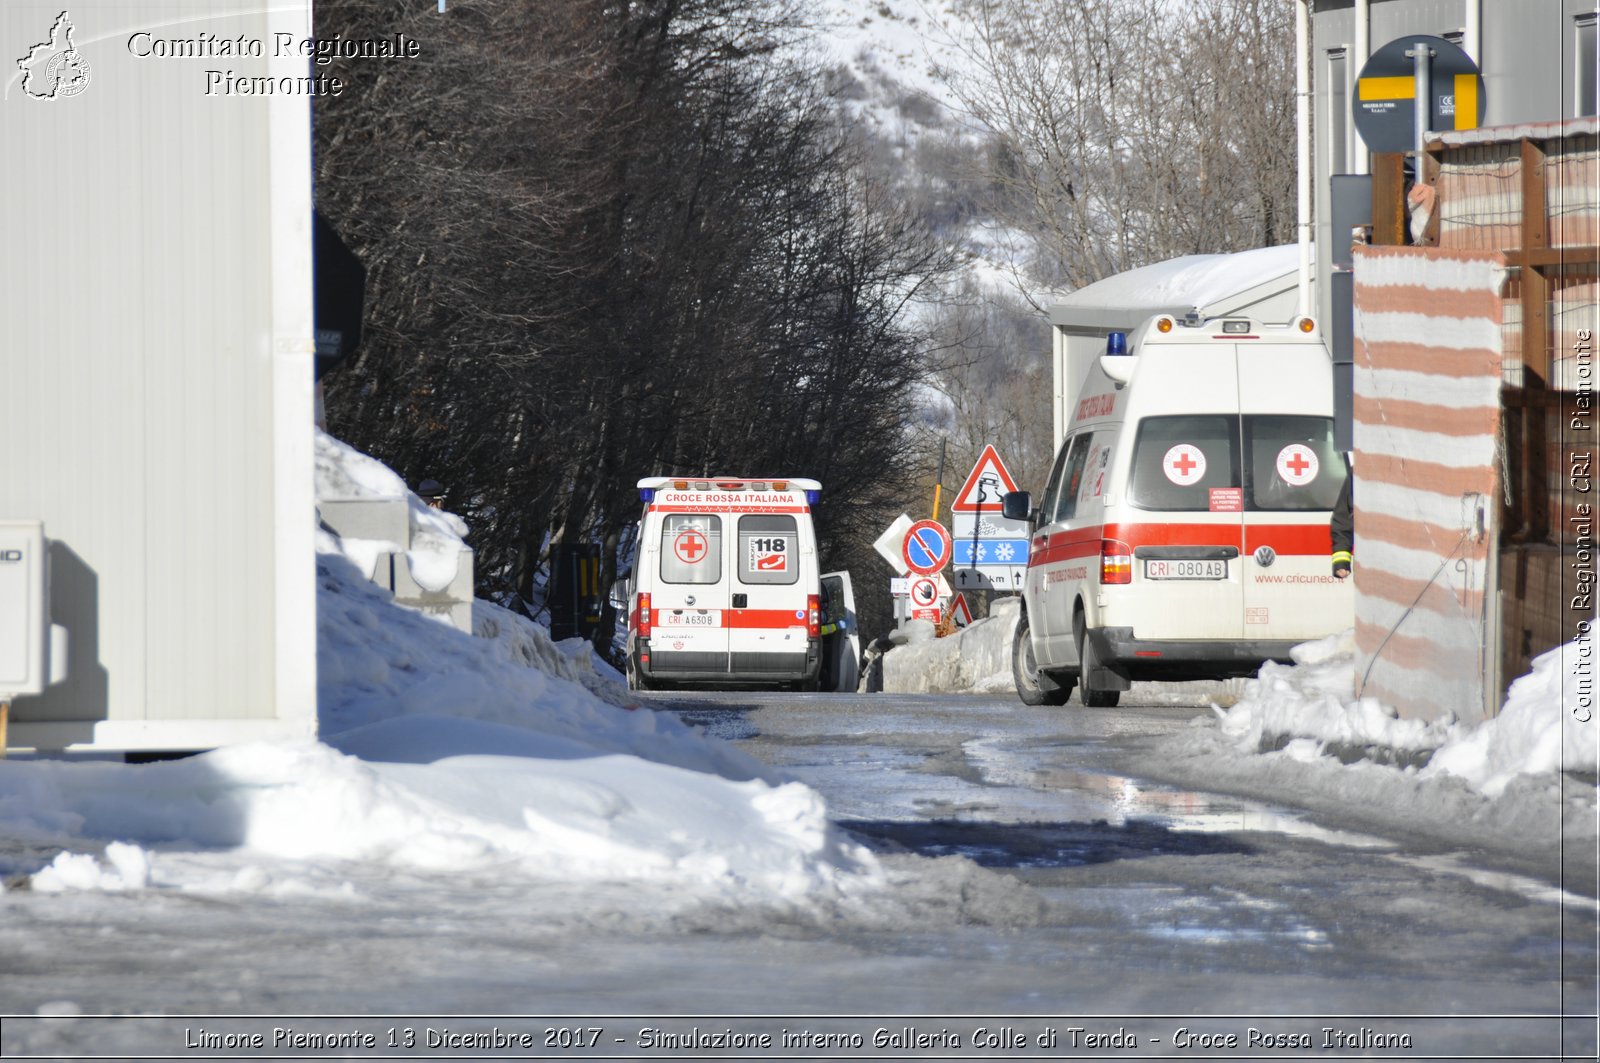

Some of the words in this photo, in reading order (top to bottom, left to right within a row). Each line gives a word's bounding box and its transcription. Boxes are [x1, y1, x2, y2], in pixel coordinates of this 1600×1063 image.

[666, 494, 702, 502] CROCE
[705, 494, 741, 502] ROSSA
[744, 495, 794, 503] ITALIANA
[754, 538, 786, 552] 118
[1150, 562, 1169, 576] CRI
[976, 573, 982, 583] 1
[988, 573, 1005, 583] km
[668, 616, 681, 624] CRI
